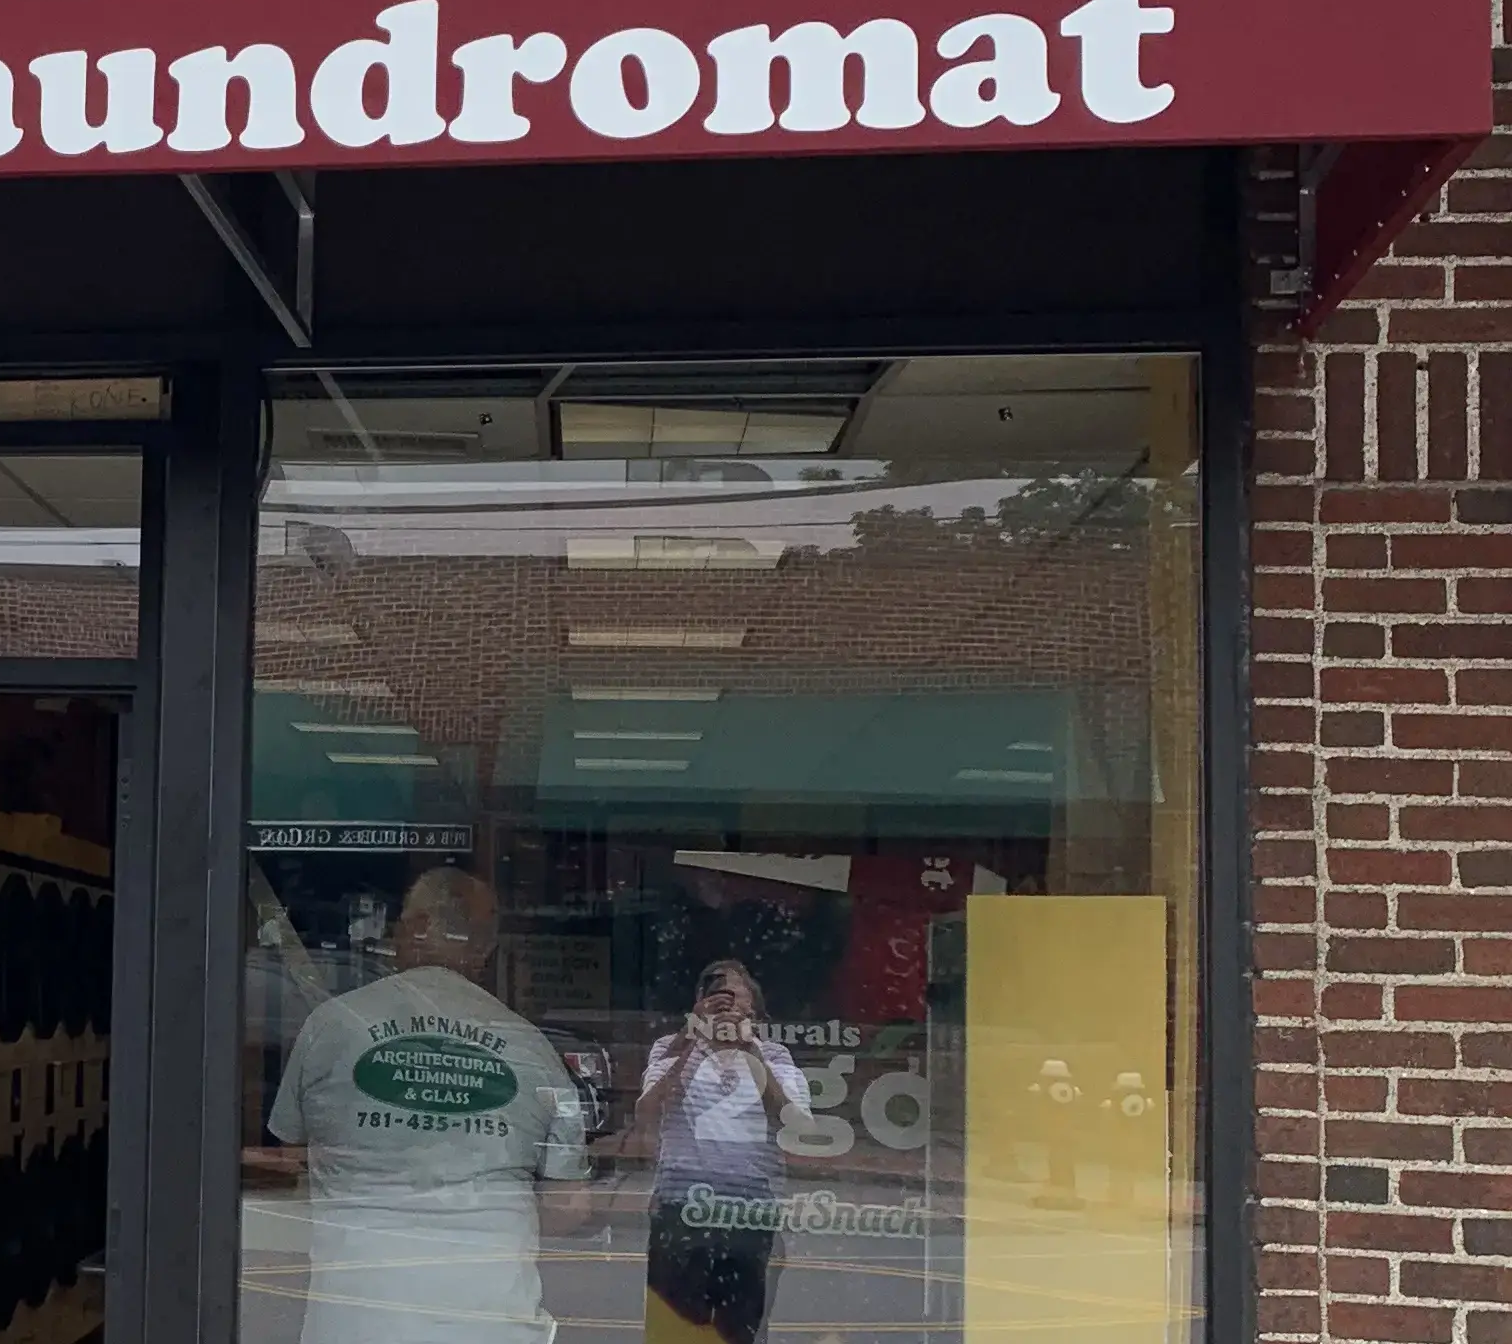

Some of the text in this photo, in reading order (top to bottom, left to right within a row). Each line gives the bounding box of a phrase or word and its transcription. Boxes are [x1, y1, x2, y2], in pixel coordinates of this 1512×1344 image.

[684, 1011, 861, 1048] Naturals
[372, 1051, 505, 1076] ARCHITECTURAL
[392, 1069, 483, 1089] ALUMINUM
[404, 1087, 470, 1105] & GLASS
[356, 1112, 509, 1138] 781-435-1159
